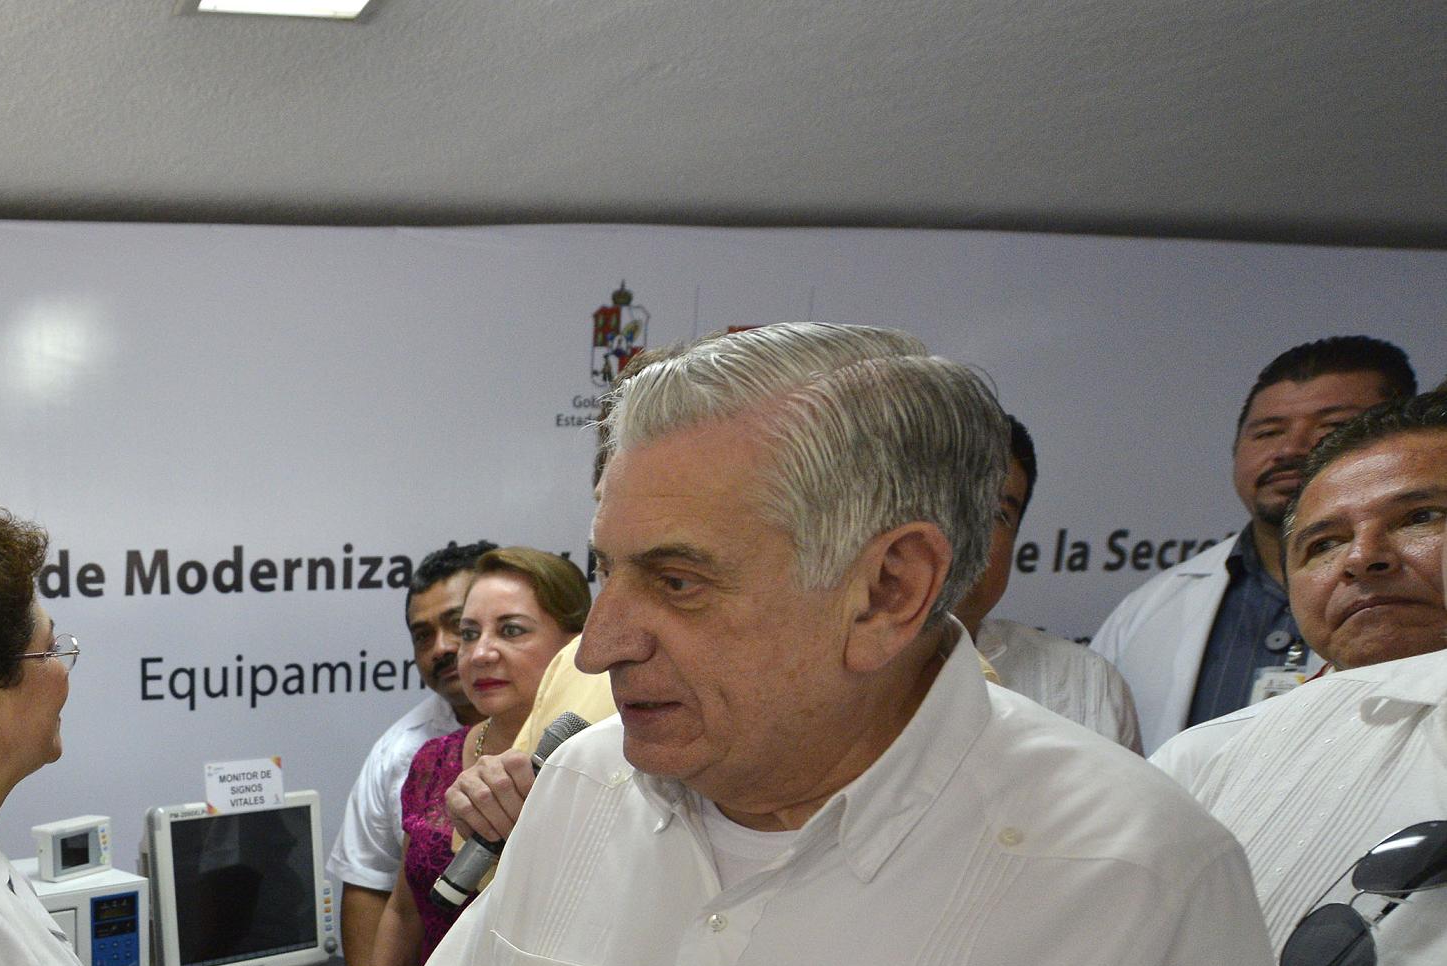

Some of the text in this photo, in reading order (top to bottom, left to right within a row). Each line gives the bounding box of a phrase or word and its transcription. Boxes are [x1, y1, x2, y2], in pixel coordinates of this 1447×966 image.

[38, 528, 1237, 598] de Moderniza e la Secr
[141, 650, 426, 711] Equipamien
[219, 770, 272, 783] MONITOR DE
[230, 783, 263, 795] SIGNOS
[230, 796, 265, 807] VITALES
